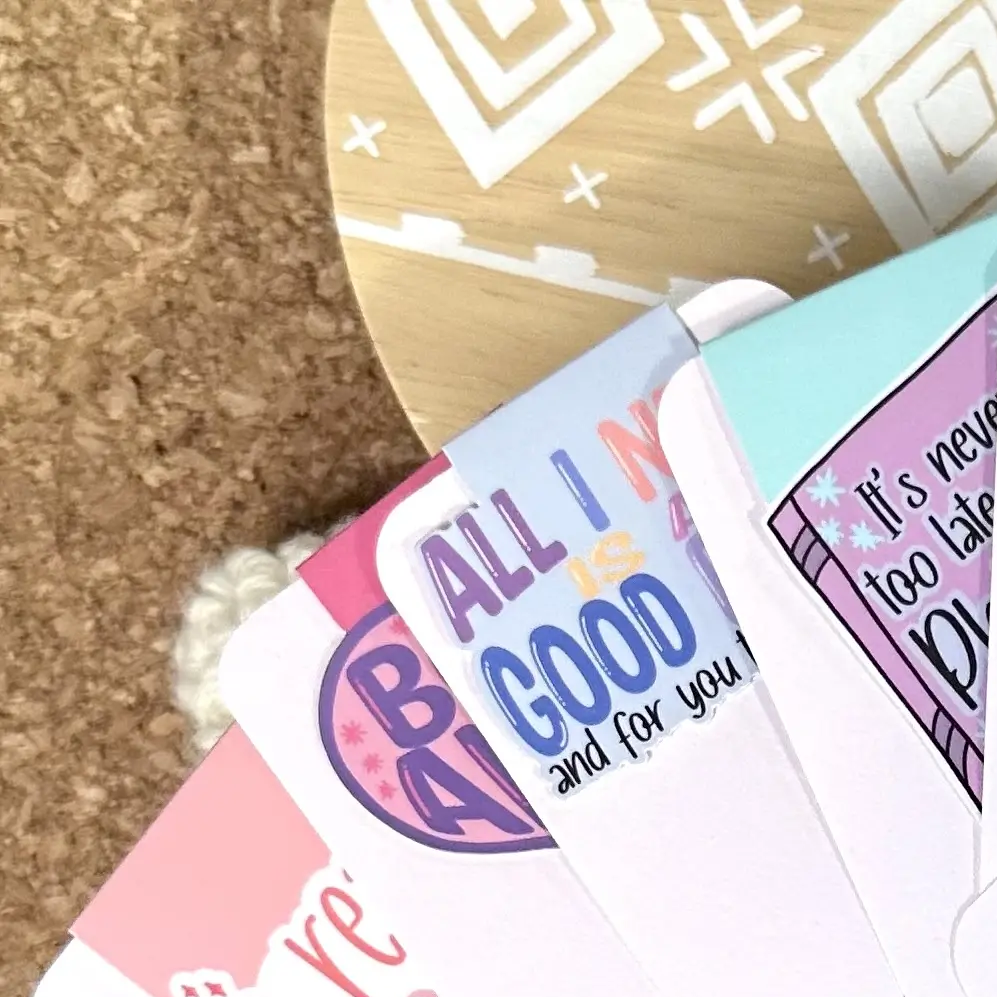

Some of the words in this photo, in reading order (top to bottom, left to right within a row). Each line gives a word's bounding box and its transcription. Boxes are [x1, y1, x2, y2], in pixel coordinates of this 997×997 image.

[421, 488, 567, 644] ALL
[550, 449, 610, 532] I
[597, 387, 674, 503] N
[854, 467, 929, 541] It's
[567, 530, 645, 599] IS
[864, 551, 939, 615] too
[481, 572, 697, 756] GOOD
[549, 729, 612, 796] and
[618, 698, 662, 759] for
[675, 654, 742, 719] you
